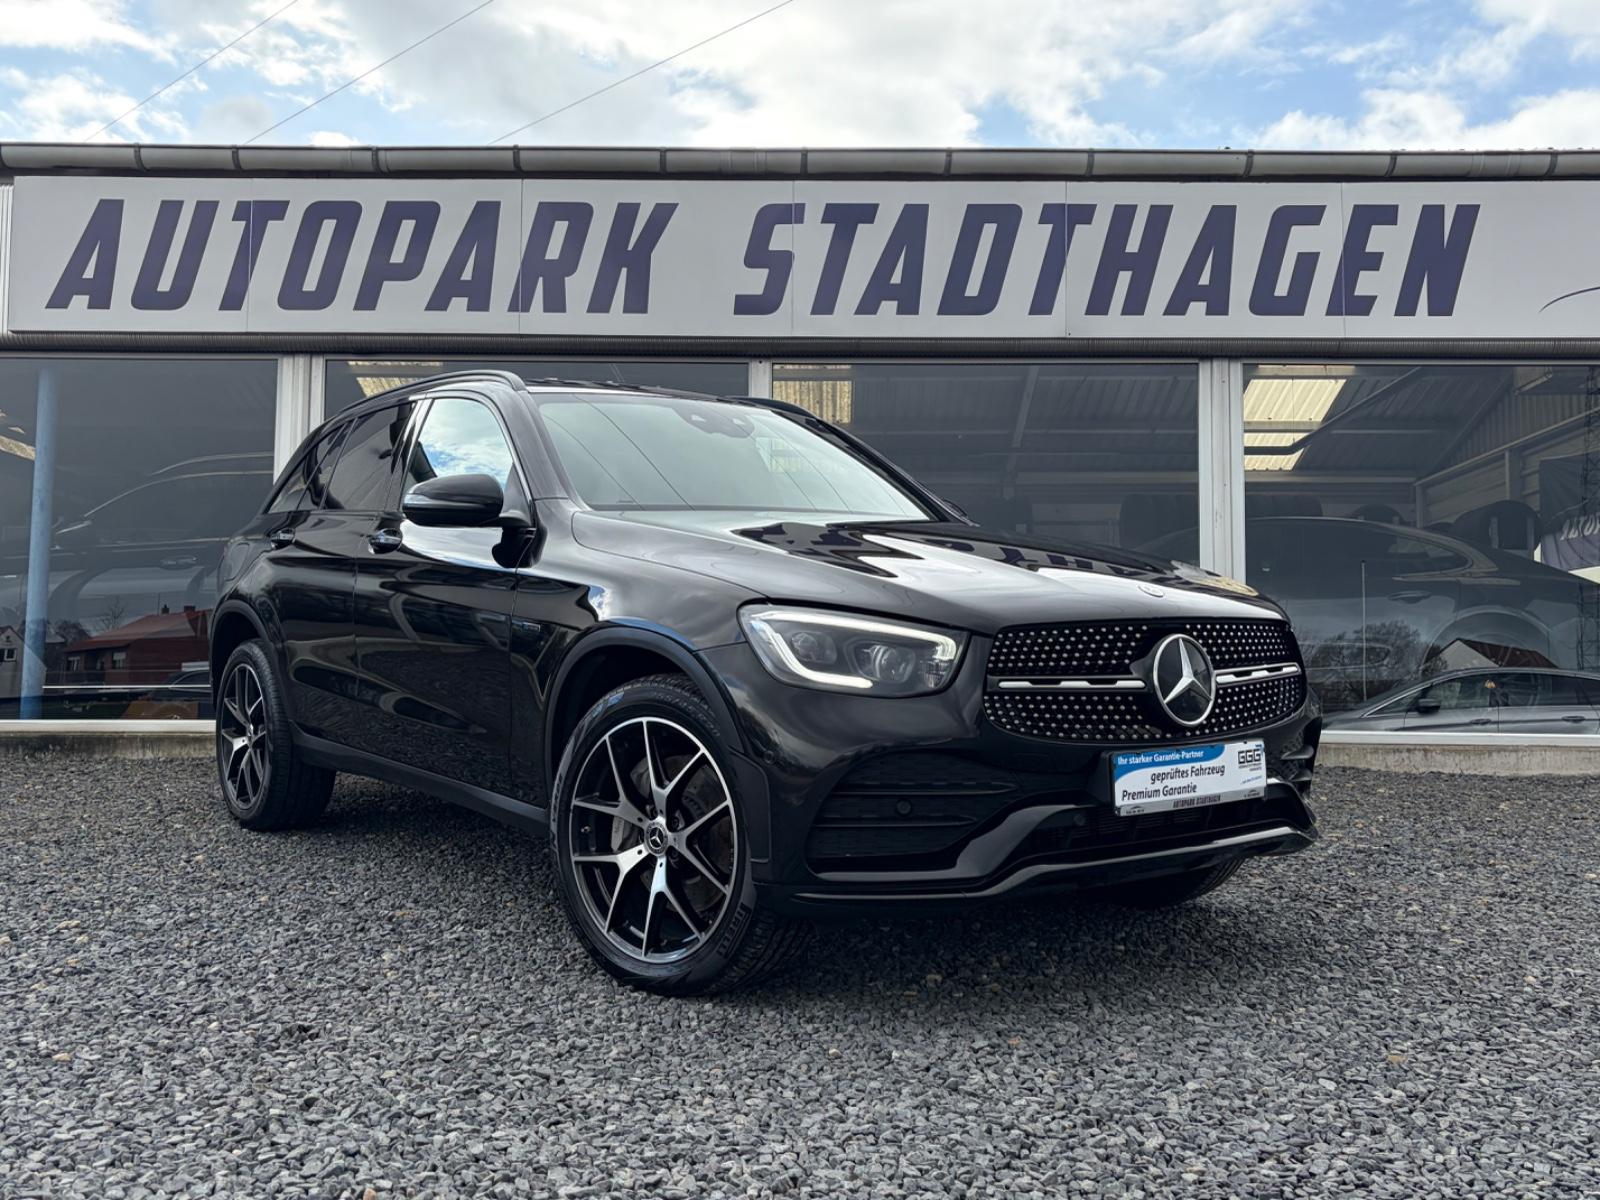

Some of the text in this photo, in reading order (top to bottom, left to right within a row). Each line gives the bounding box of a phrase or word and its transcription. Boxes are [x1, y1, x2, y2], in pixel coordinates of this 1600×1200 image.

[45, 198, 1481, 316] AUTOPARK STADTHAGEN
[1117, 750, 1204, 765] Ihr starker Garantie-Partner
[1237, 748, 1262, 765] GGG
[1150, 767, 1190, 784] geprüftes
[1190, 764, 1226, 778] Fahrzeug
[1121, 782, 1198, 802] Premium Garantie
